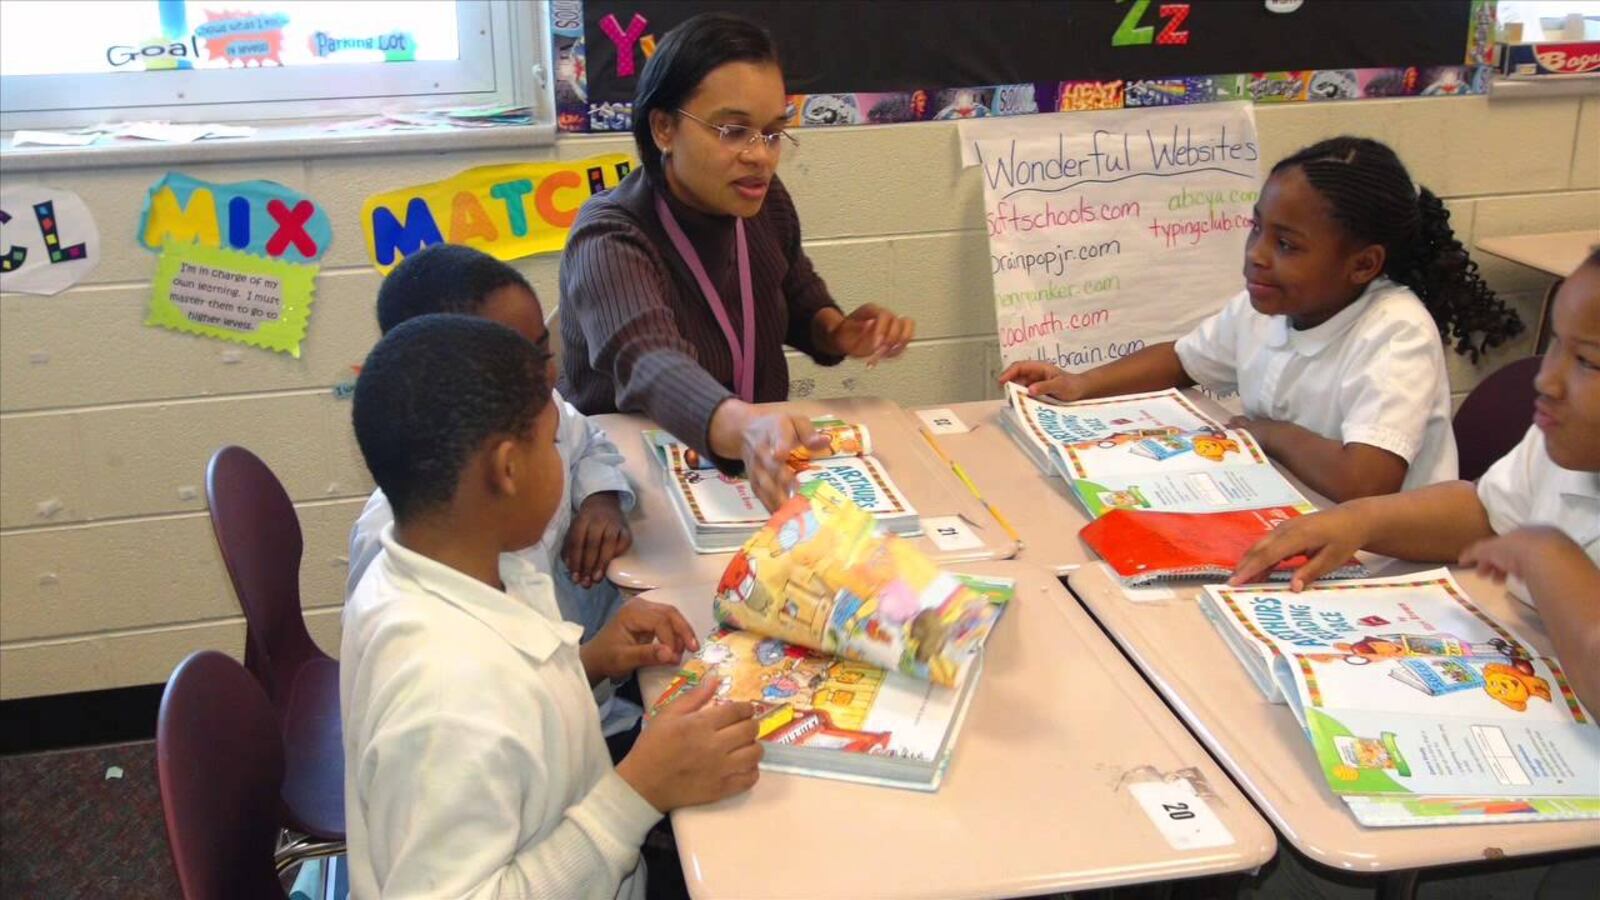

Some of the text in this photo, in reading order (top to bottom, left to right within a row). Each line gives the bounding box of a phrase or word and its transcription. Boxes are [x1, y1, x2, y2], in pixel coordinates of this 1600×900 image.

[107, 35, 199, 66] Goal
[315, 32, 406, 57] Parking Lot
[975, 125, 1257, 190] Wonderful Websites
[144, 186, 317, 258] MIX
[180, 262, 280, 289] I'm in charge of my
[169, 292, 278, 320] master them to go to
[172, 278, 195, 287] own
[198, 281, 241, 298] learning.
[254, 293, 280, 306] must
[826, 465, 880, 508] ARTHUR'S
[937, 527, 958, 536] 21
[1250, 597, 1331, 647] ARTHUR'S
[1289, 604, 1345, 641] READING
[1319, 611, 1360, 632] RACE
[1162, 802, 1196, 820] 20
